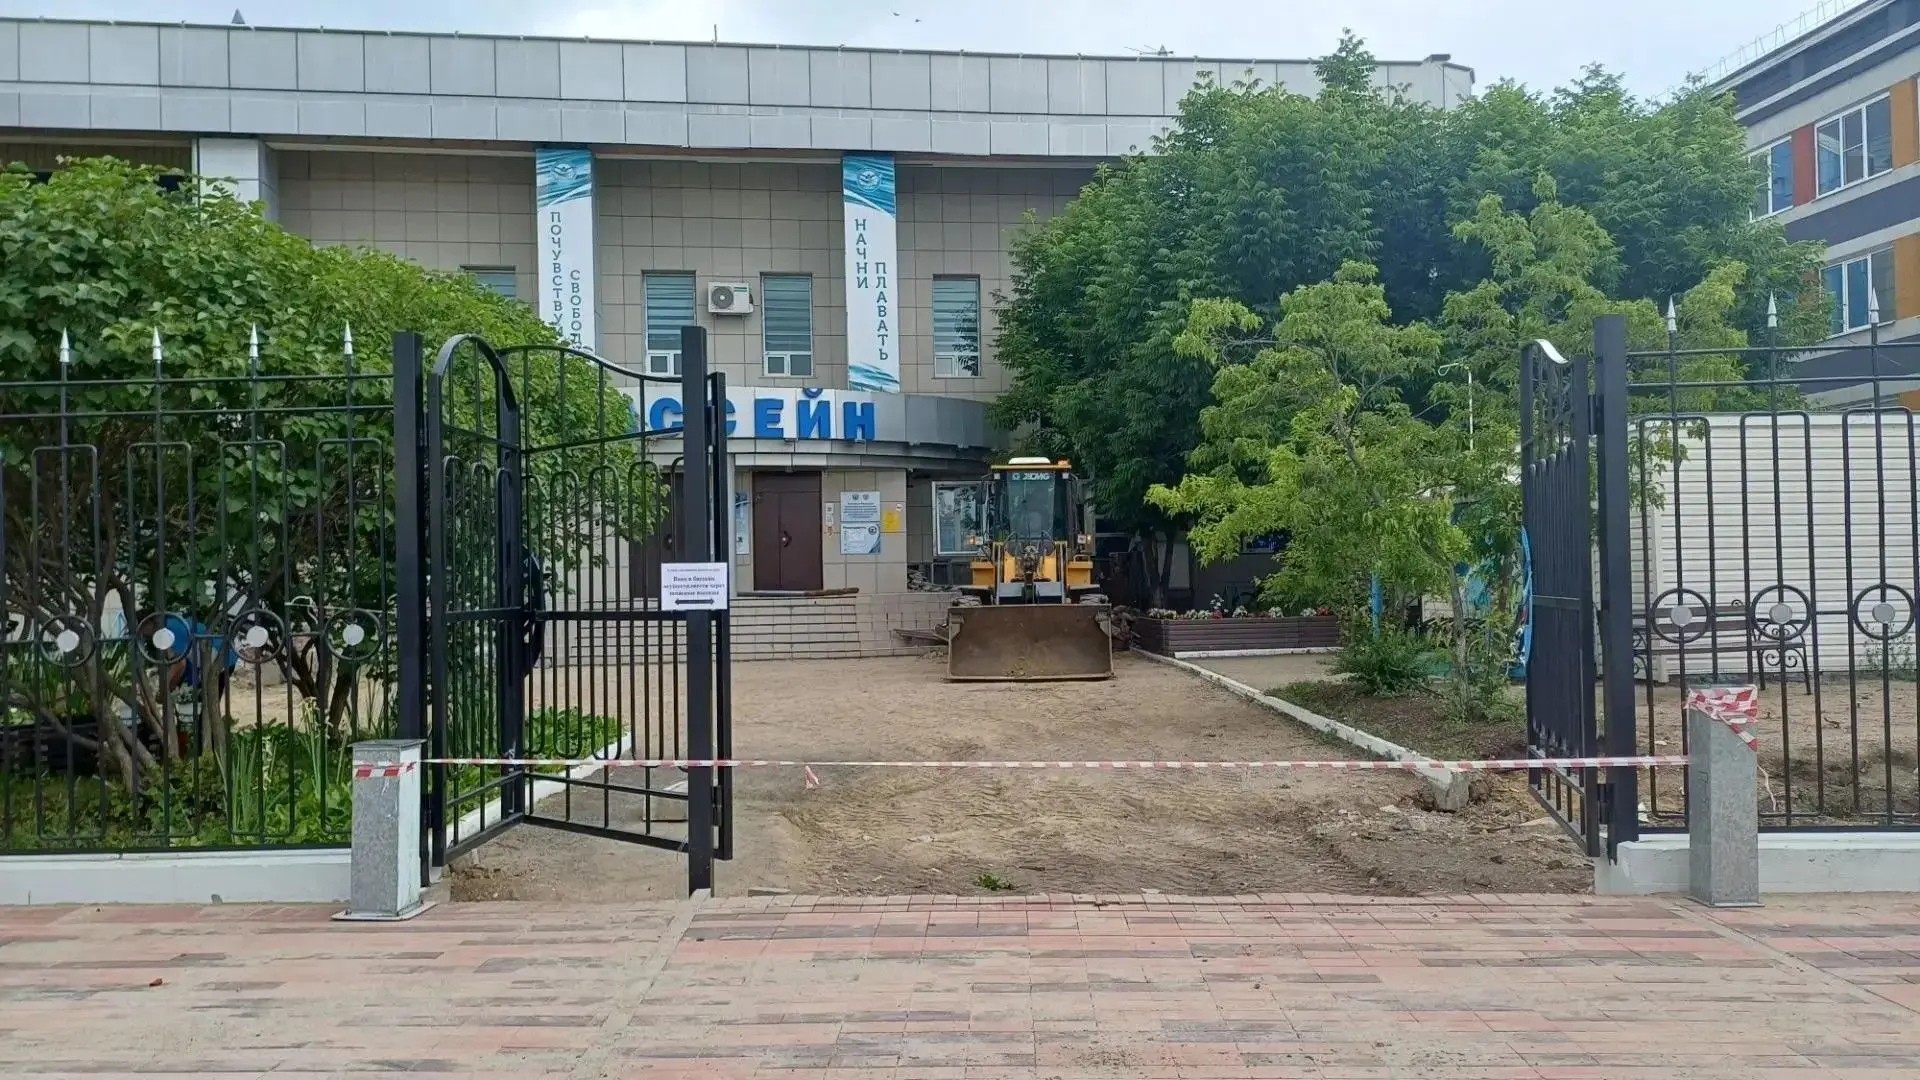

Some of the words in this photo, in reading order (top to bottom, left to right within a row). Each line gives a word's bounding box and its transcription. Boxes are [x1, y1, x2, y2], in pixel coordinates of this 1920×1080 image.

[855, 218, 869, 288] НАЧНИ
[569, 269, 582, 349] СВОБОД
[875, 261, 889, 361] ПЛАВАТЬ
